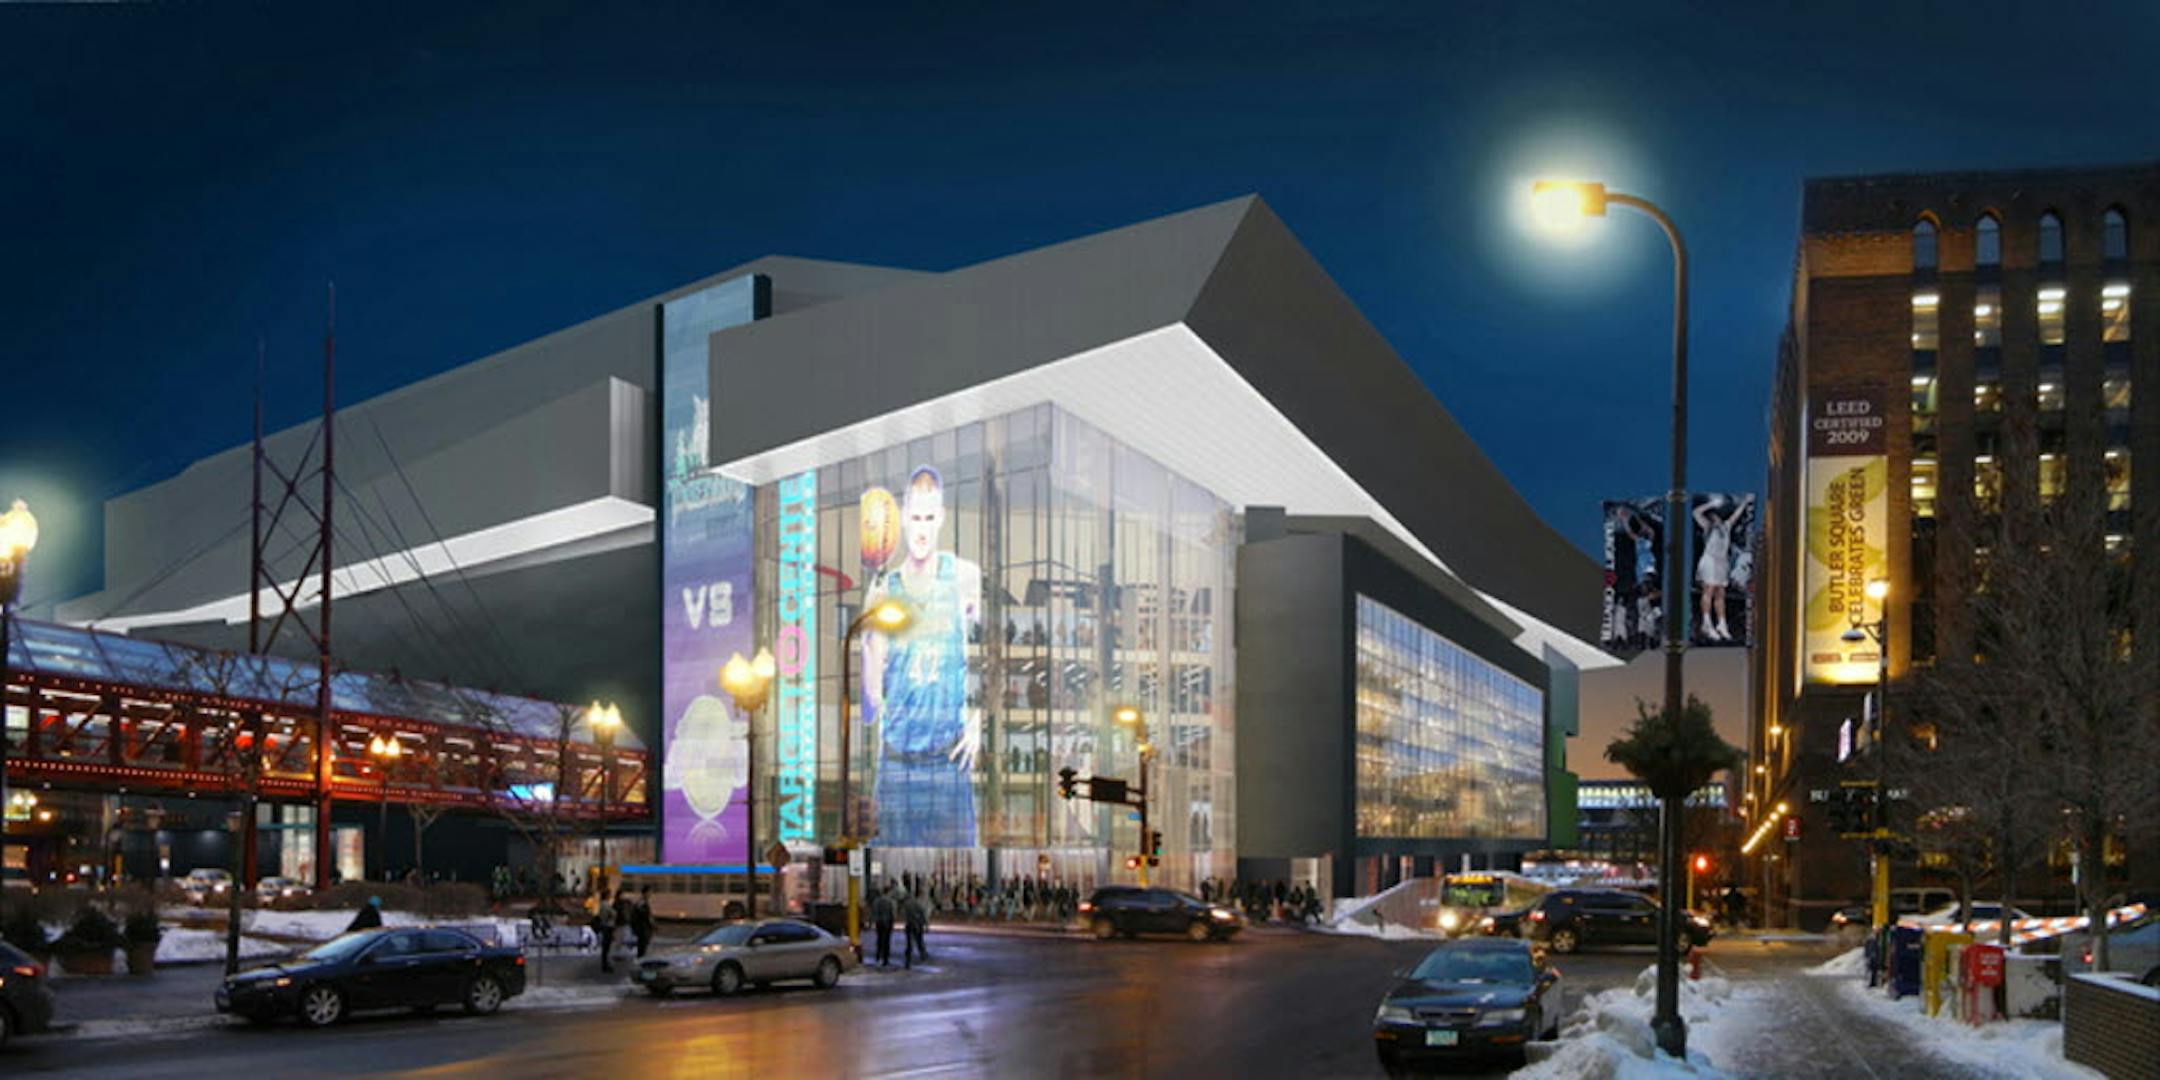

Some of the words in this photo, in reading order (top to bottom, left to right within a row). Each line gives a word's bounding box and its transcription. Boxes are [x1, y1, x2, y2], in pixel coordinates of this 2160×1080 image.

[1813, 416, 1882, 430] CERTIFIED
[1826, 400, 1870, 416] LEED
[1826, 428, 1871, 445] 2009
[1829, 482, 1846, 548] SQUARE
[1848, 467, 1866, 521] GREEN
[1829, 551, 1845, 613] BUTLER
[1848, 526, 1865, 625] CELEBRATES
[682, 581, 732, 629] VS
[778, 678, 804, 842] TARGET
